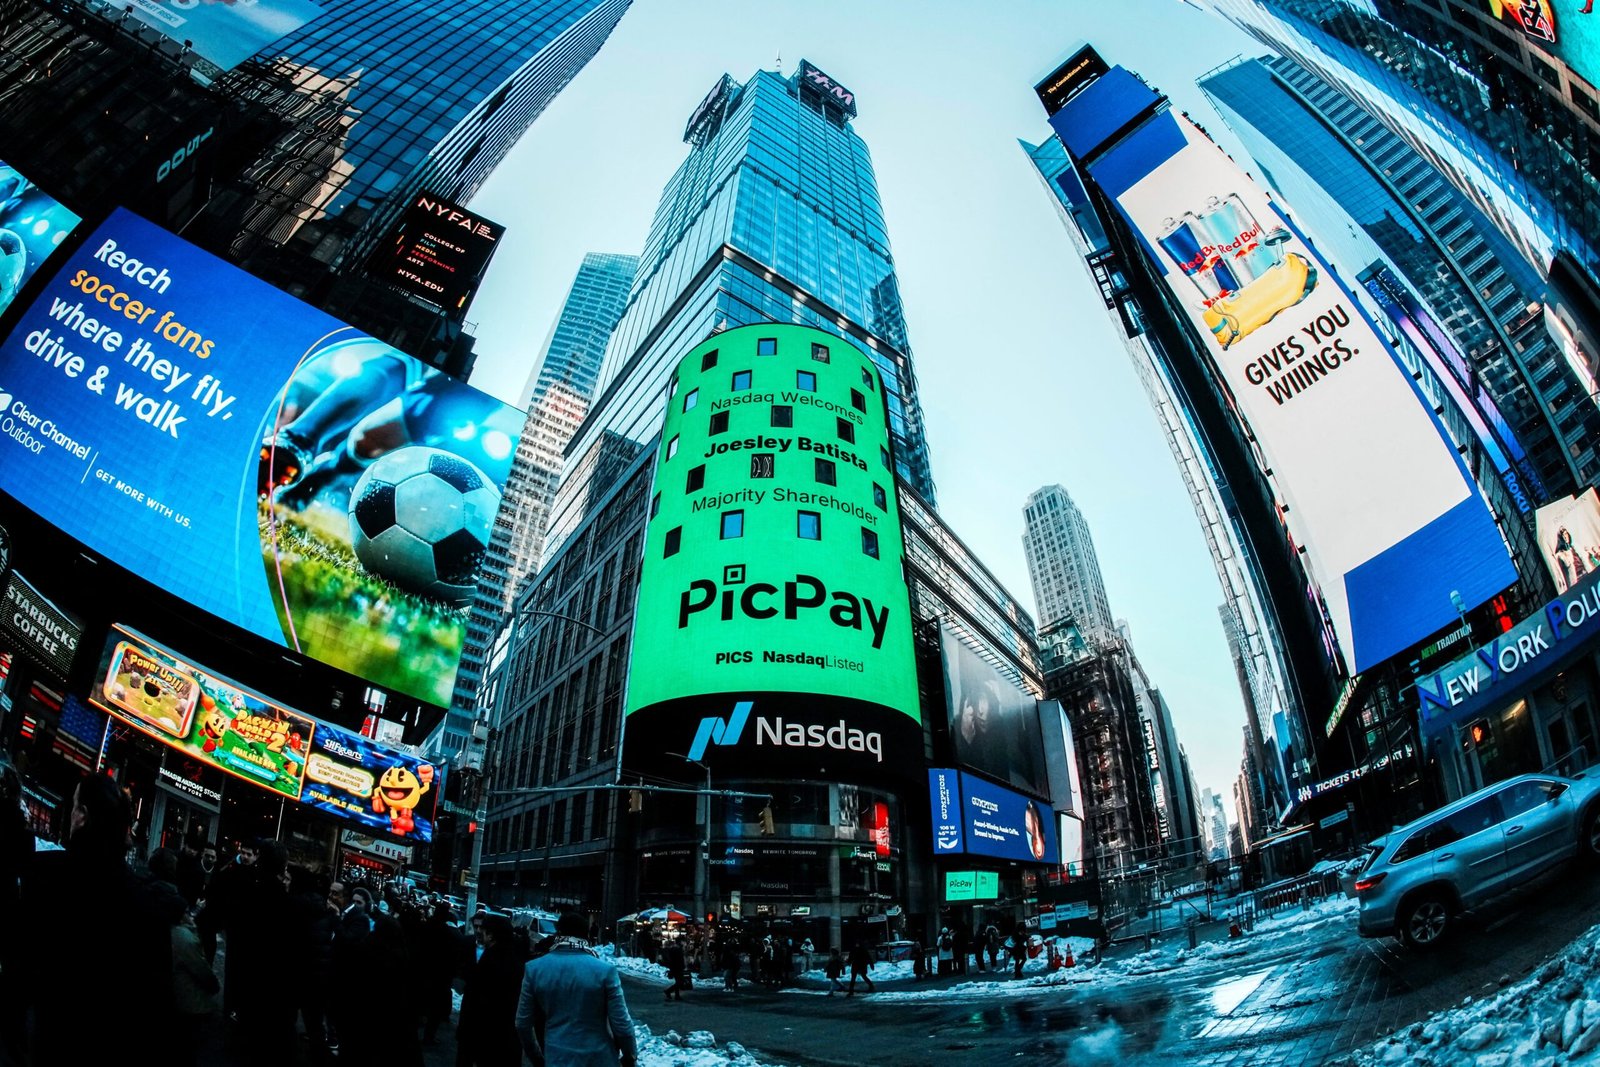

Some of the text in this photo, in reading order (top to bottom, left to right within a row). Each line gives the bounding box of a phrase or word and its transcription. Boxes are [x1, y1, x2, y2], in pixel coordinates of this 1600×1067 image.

[418, 198, 471, 231] NYFA
[415, 244, 437, 257] MEDIA
[420, 238, 436, 248] FILM
[424, 232, 466, 254] COLLEGE OF
[1217, 220, 1261, 254] Red Bull
[94, 238, 172, 295] Reach
[406, 256, 425, 267] ARTS
[411, 249, 455, 273] PERFORMING
[1180, 252, 1205, 271] Red
[398, 268, 444, 293] NYFA.EDU
[70, 269, 216, 360] soccer fans
[49, 296, 237, 421] where they fly,
[1245, 304, 1350, 386] GIVES YOU
[24, 328, 188, 439] drive & walk
[1265, 338, 1360, 406] WIIINGS.
[710, 391, 864, 426] Nasdaq Welcomes
[1, 417, 45, 455] Outdoor
[11, 401, 91, 461] Clear Channel
[704, 435, 868, 472] Joesley Batista
[95, 468, 192, 529] GET MORE WITH US.
[692, 487, 878, 527] Majority Shareholder
[7, 584, 77, 650] STARBUCKS
[678, 563, 890, 650] PicPay
[13, 612, 59, 656] COFFEE
[1416, 674, 1479, 722] NEW
[1477, 638, 1549, 684] YORK
[1545, 577, 1600, 642] POLI
[129, 654, 184, 693] Power Up!!!
[715, 650, 753, 665] PICS
[236, 709, 290, 735] PAC-MAN
[237, 721, 272, 738] WORLD
[231, 745, 263, 765] AVAILABLE
[266, 732, 286, 754] 2
[756, 716, 883, 763] Nasdaq
[175, 781, 202, 798] NEW YORK
[203, 788, 222, 801] STORE
[938, 774, 948, 820] GUMPTION
[1315, 772, 1350, 793] TICKETS
[309, 789, 364, 813] AVAILABLE NOW
[734, 847, 754, 855] Nasdaq
[949, 879, 973, 889] PicPay
